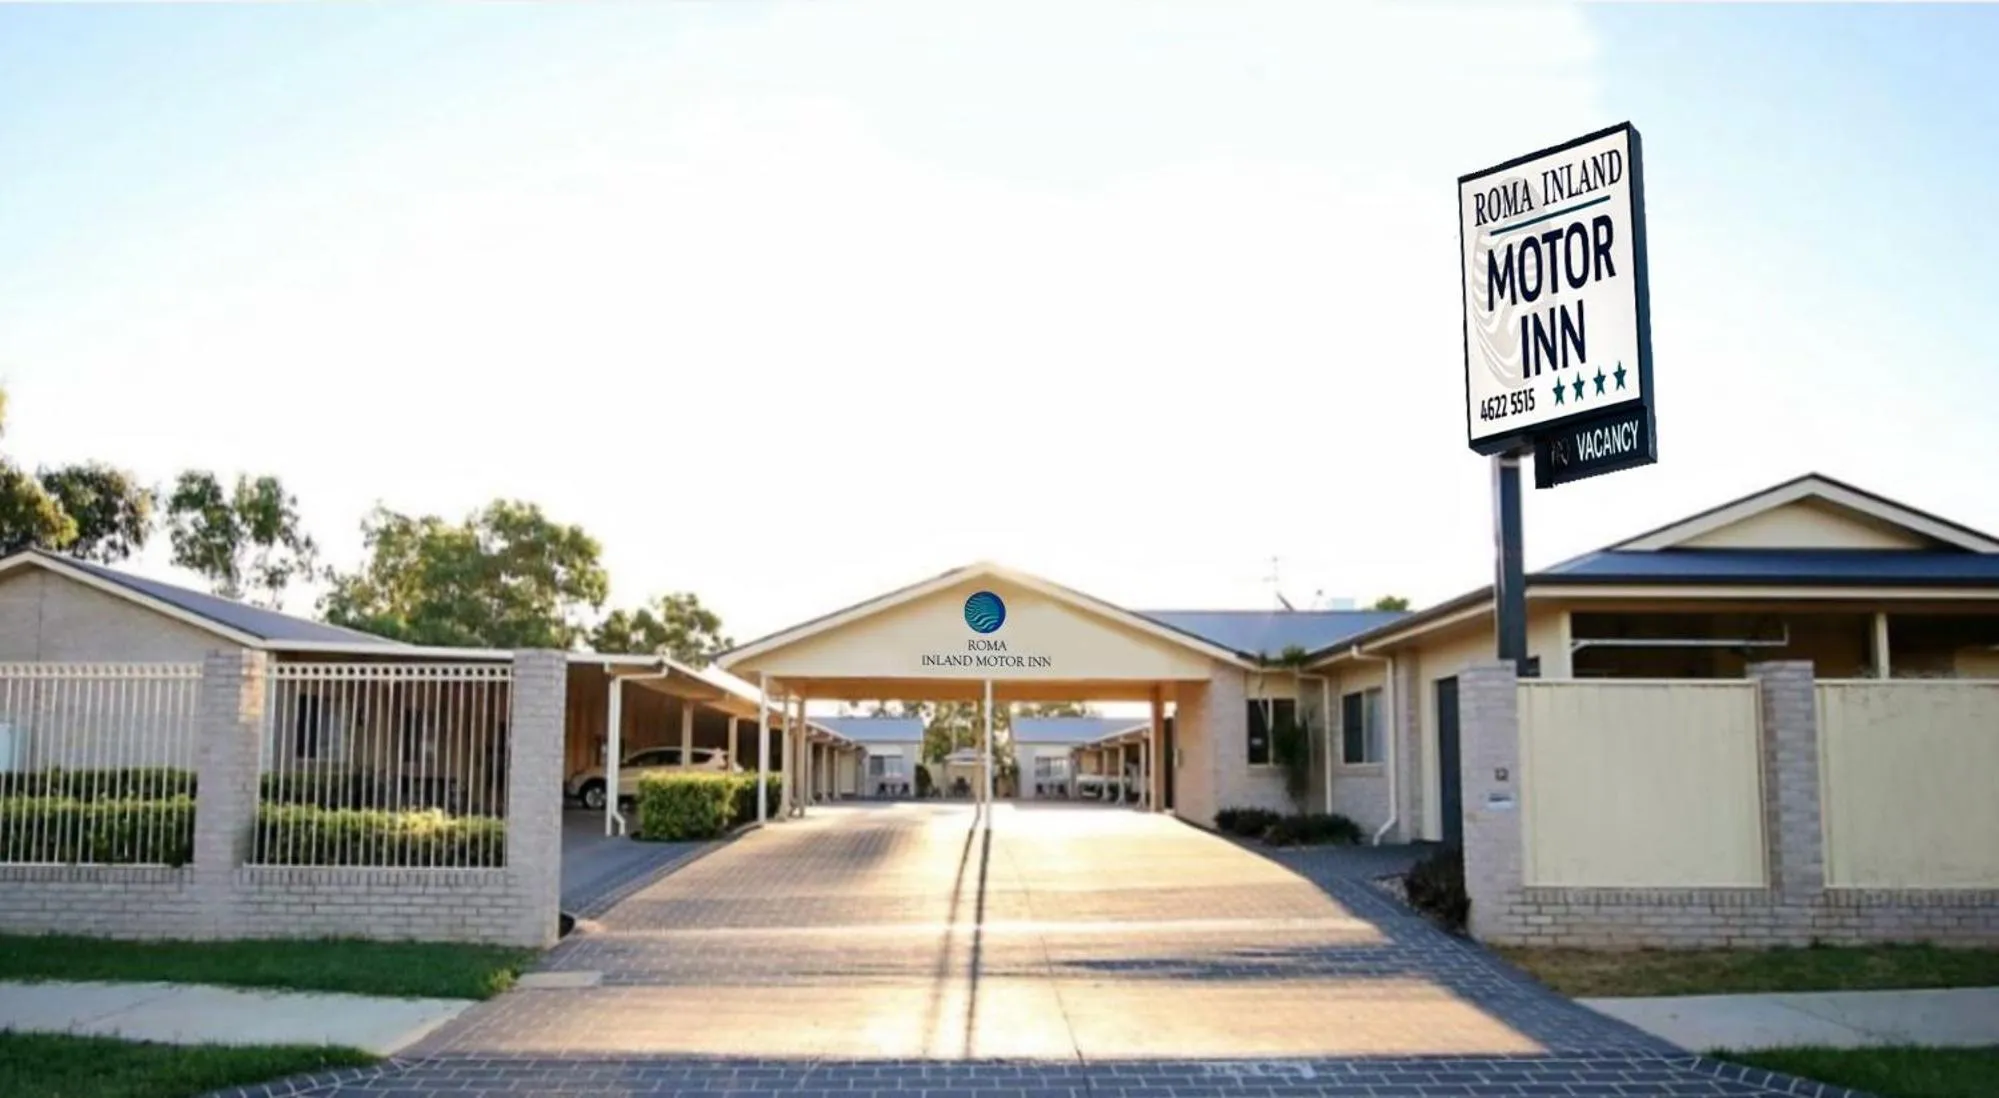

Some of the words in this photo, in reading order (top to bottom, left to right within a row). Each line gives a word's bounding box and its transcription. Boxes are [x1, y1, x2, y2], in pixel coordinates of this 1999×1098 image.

[1474, 179, 1534, 227] ROMA
[1542, 149, 1622, 206] INLAND
[1487, 215, 1616, 311] MOTOR
[1521, 299, 1586, 378] INN
[1480, 394, 1508, 422] 4622
[1511, 388, 1535, 416] 5515
[1576, 420, 1639, 462] VACANCY
[922, 655, 973, 666] INLAND
[976, 656, 1025, 668] MOTOR
[1028, 656, 1052, 668] INN
[968, 639, 1008, 651] ROMA
